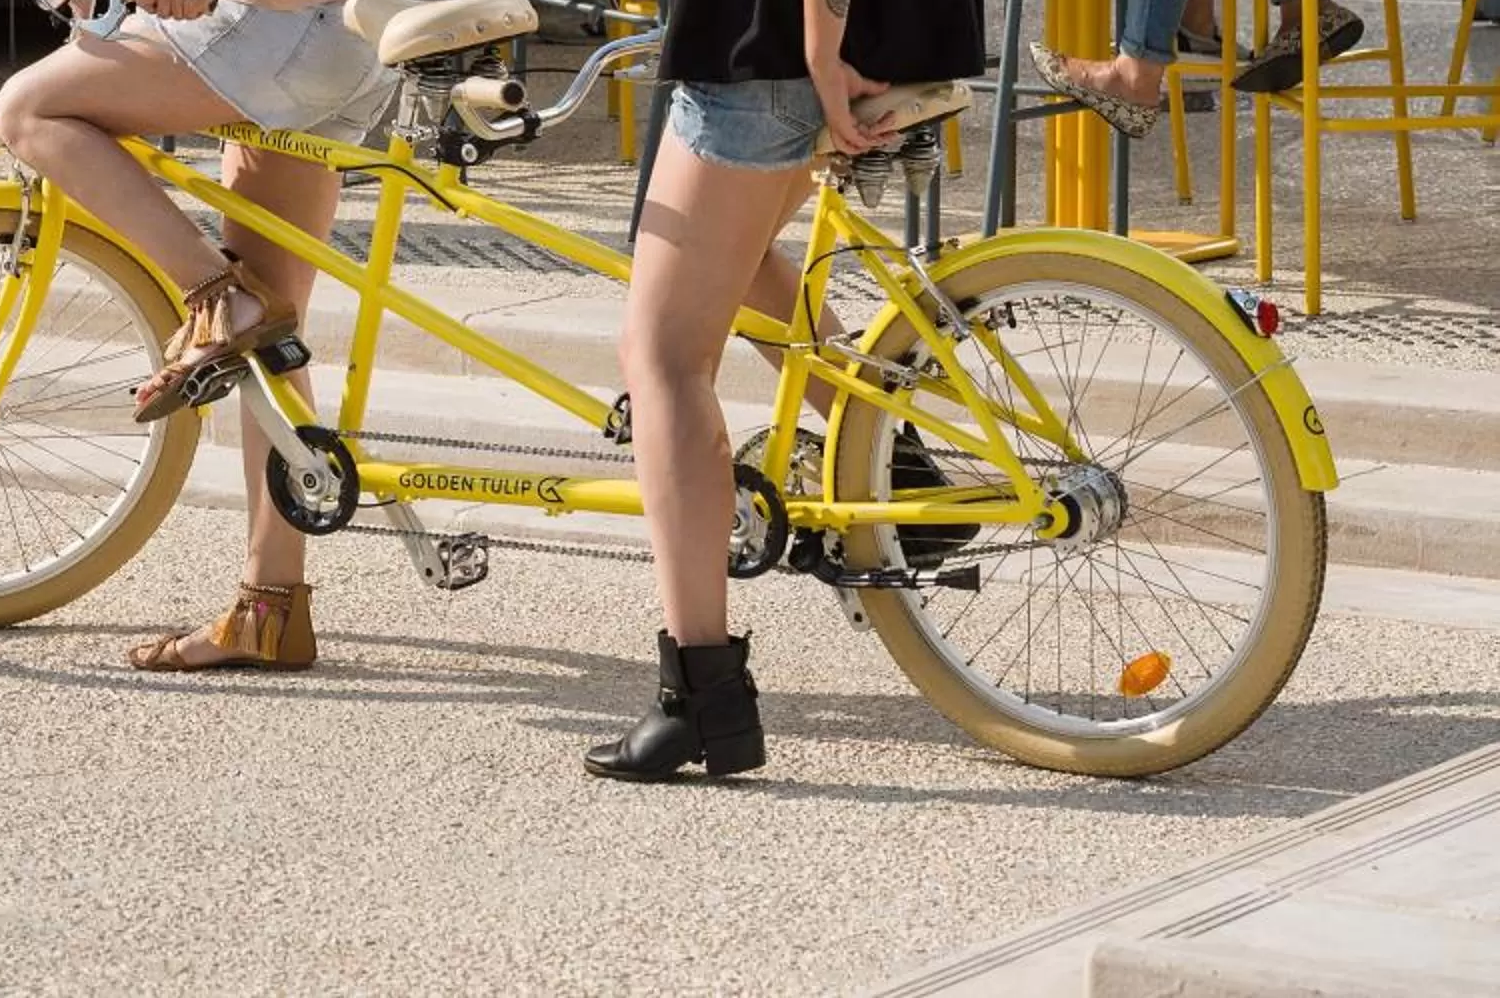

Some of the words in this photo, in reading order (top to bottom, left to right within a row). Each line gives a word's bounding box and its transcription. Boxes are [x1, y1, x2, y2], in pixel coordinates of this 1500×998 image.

[220, 123, 254, 142] new
[260, 129, 333, 158] follower
[399, 473, 474, 492] GOLDEN
[481, 477, 532, 496] TULIP
